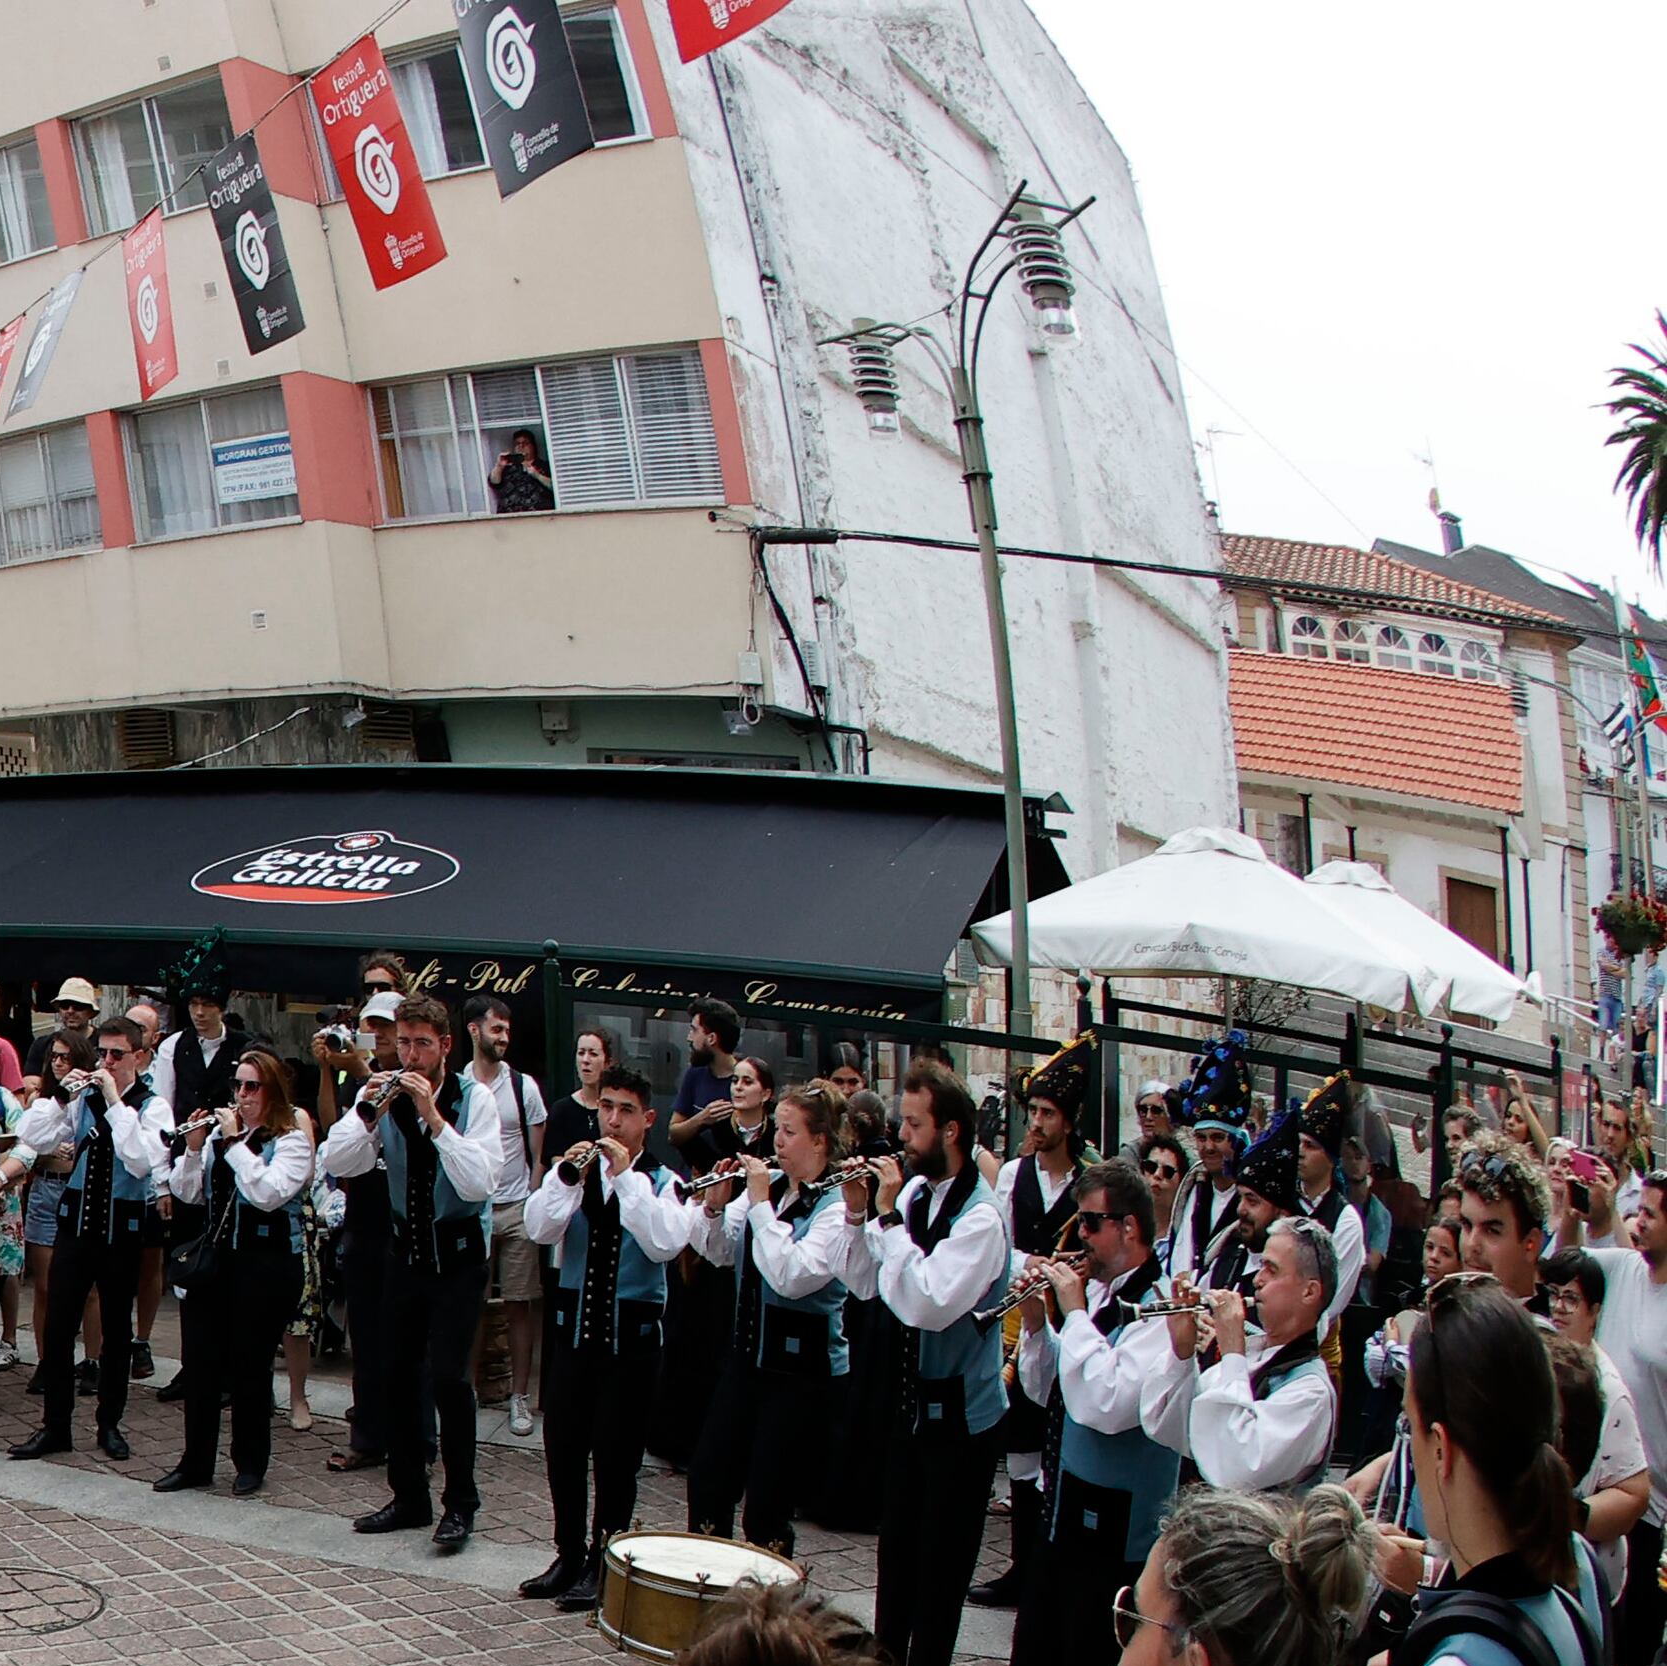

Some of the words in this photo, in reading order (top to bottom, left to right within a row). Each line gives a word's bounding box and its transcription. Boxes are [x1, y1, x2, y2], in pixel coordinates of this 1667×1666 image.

[332, 57, 366, 94] festival
[323, 68, 389, 126] Ortigueira
[525, 127, 550, 149] Concello
[549, 123, 560, 135] de
[527, 133, 560, 158] Ortigueira
[216, 151, 246, 183] festival
[210, 163, 263, 210] Ortigueira
[126, 232, 162, 275] Ortigueira
[217, 449, 258, 463] MORGRAN
[258, 443, 292, 457] GESTION
[232, 865, 391, 891] Galicia
[245, 849, 422, 876] Estrella
[464, 960, 537, 995] Pub
